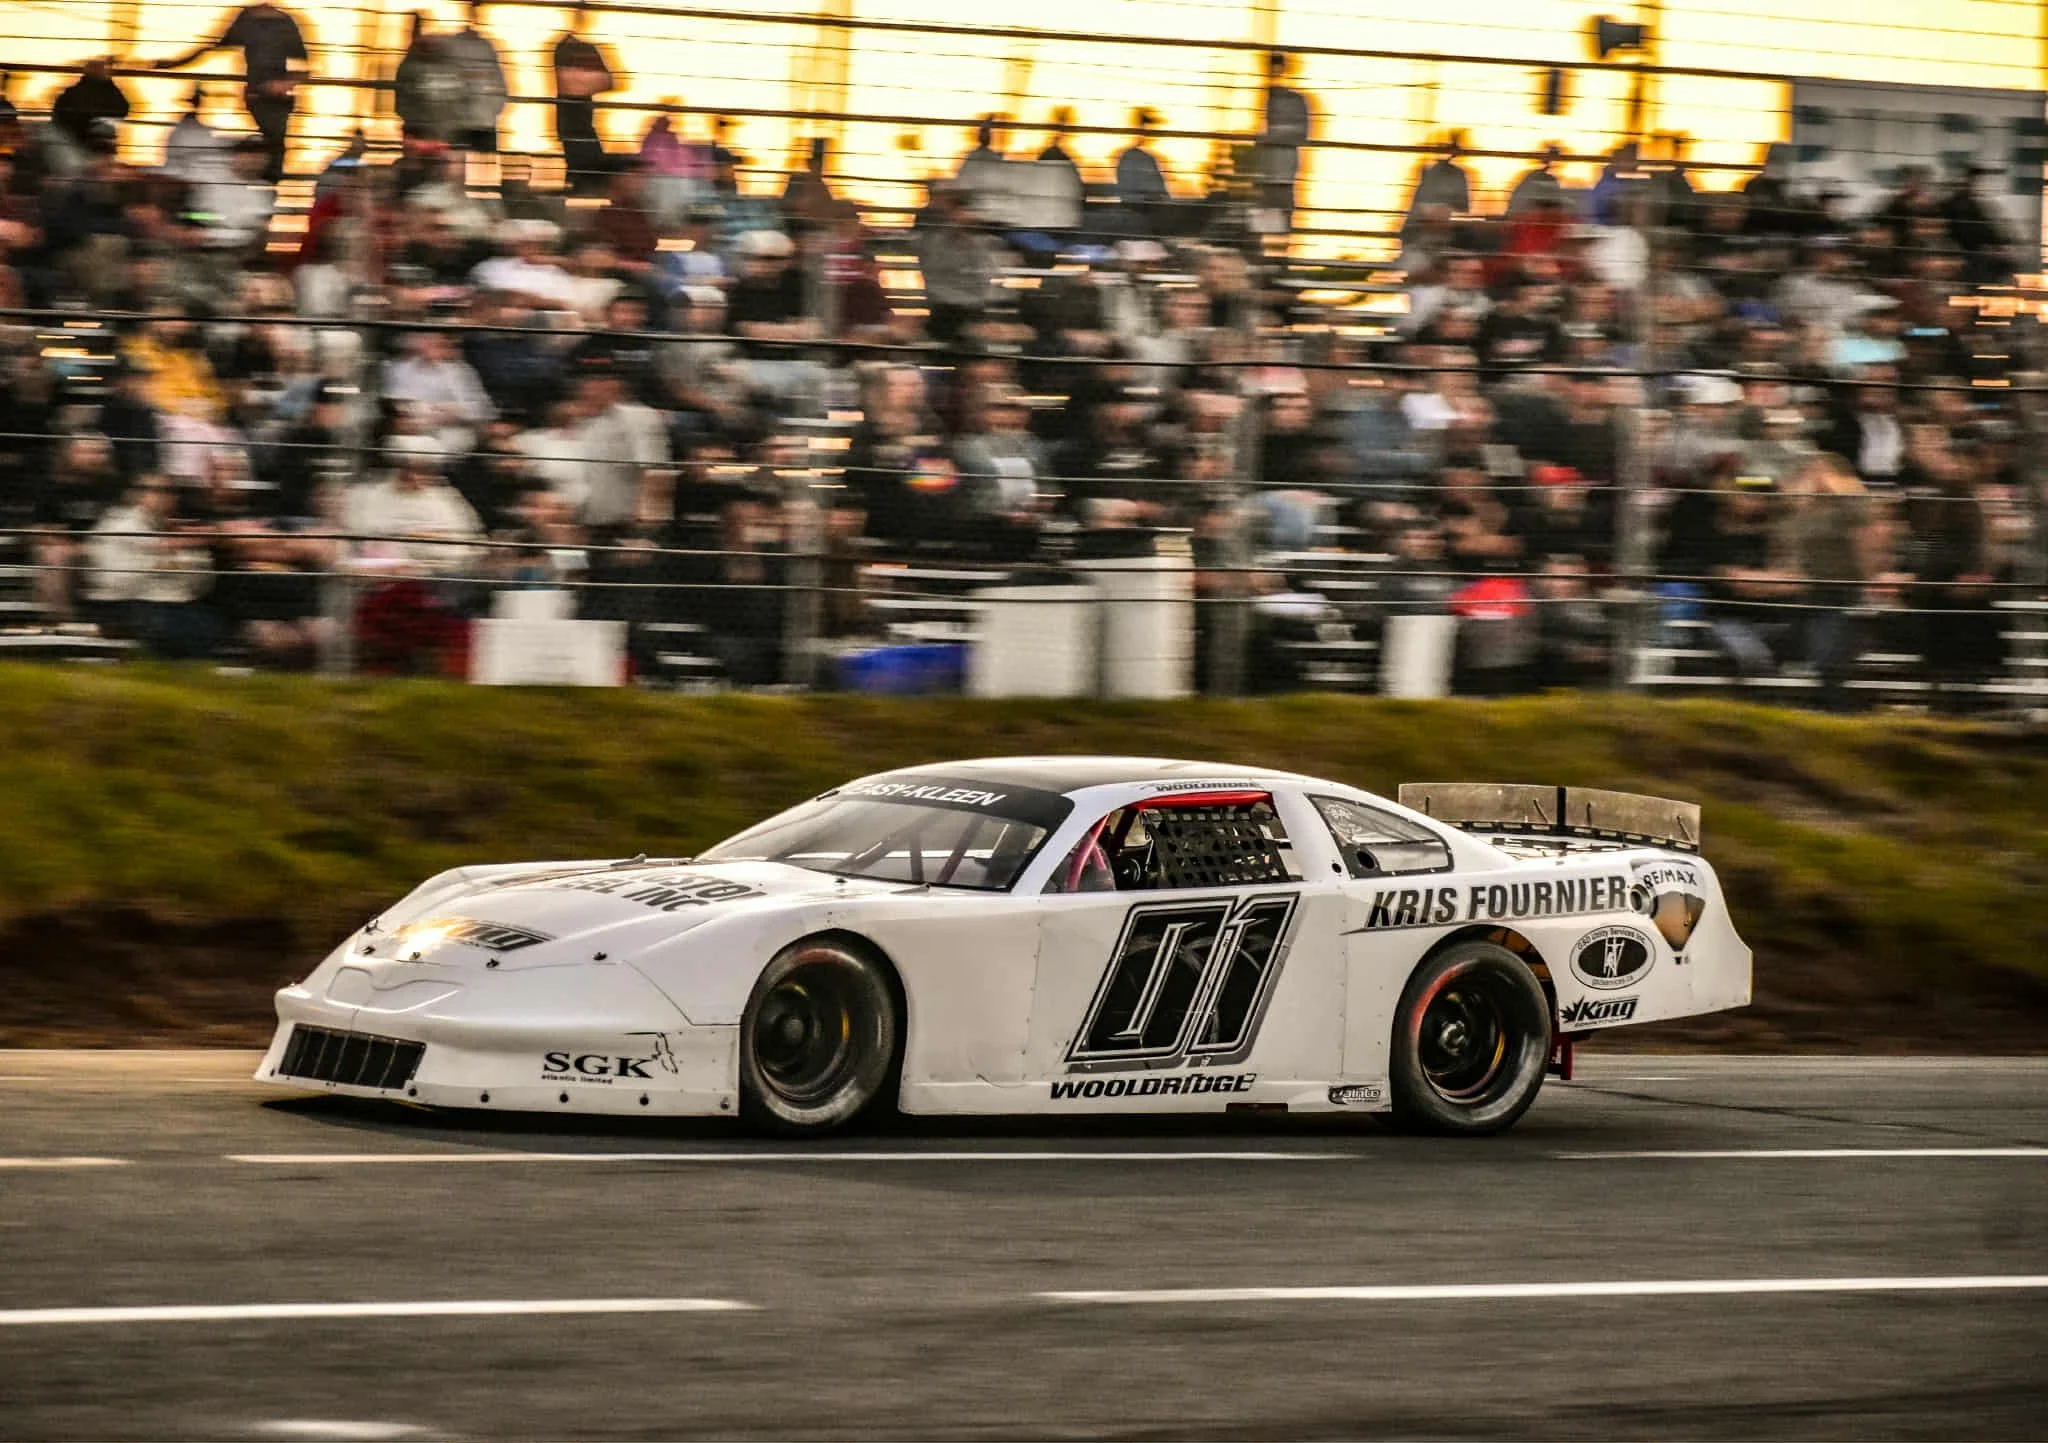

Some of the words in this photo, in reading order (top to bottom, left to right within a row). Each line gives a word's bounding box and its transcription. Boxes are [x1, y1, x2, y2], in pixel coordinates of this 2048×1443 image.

[1643, 869, 1697, 890] RE/MAX
[1367, 887, 1457, 928] KRIS
[1468, 874, 1627, 920] FOURNIER
[543, 1051, 654, 1079] SGK
[1050, 1073, 1257, 1099] WOOLDRIDGE
